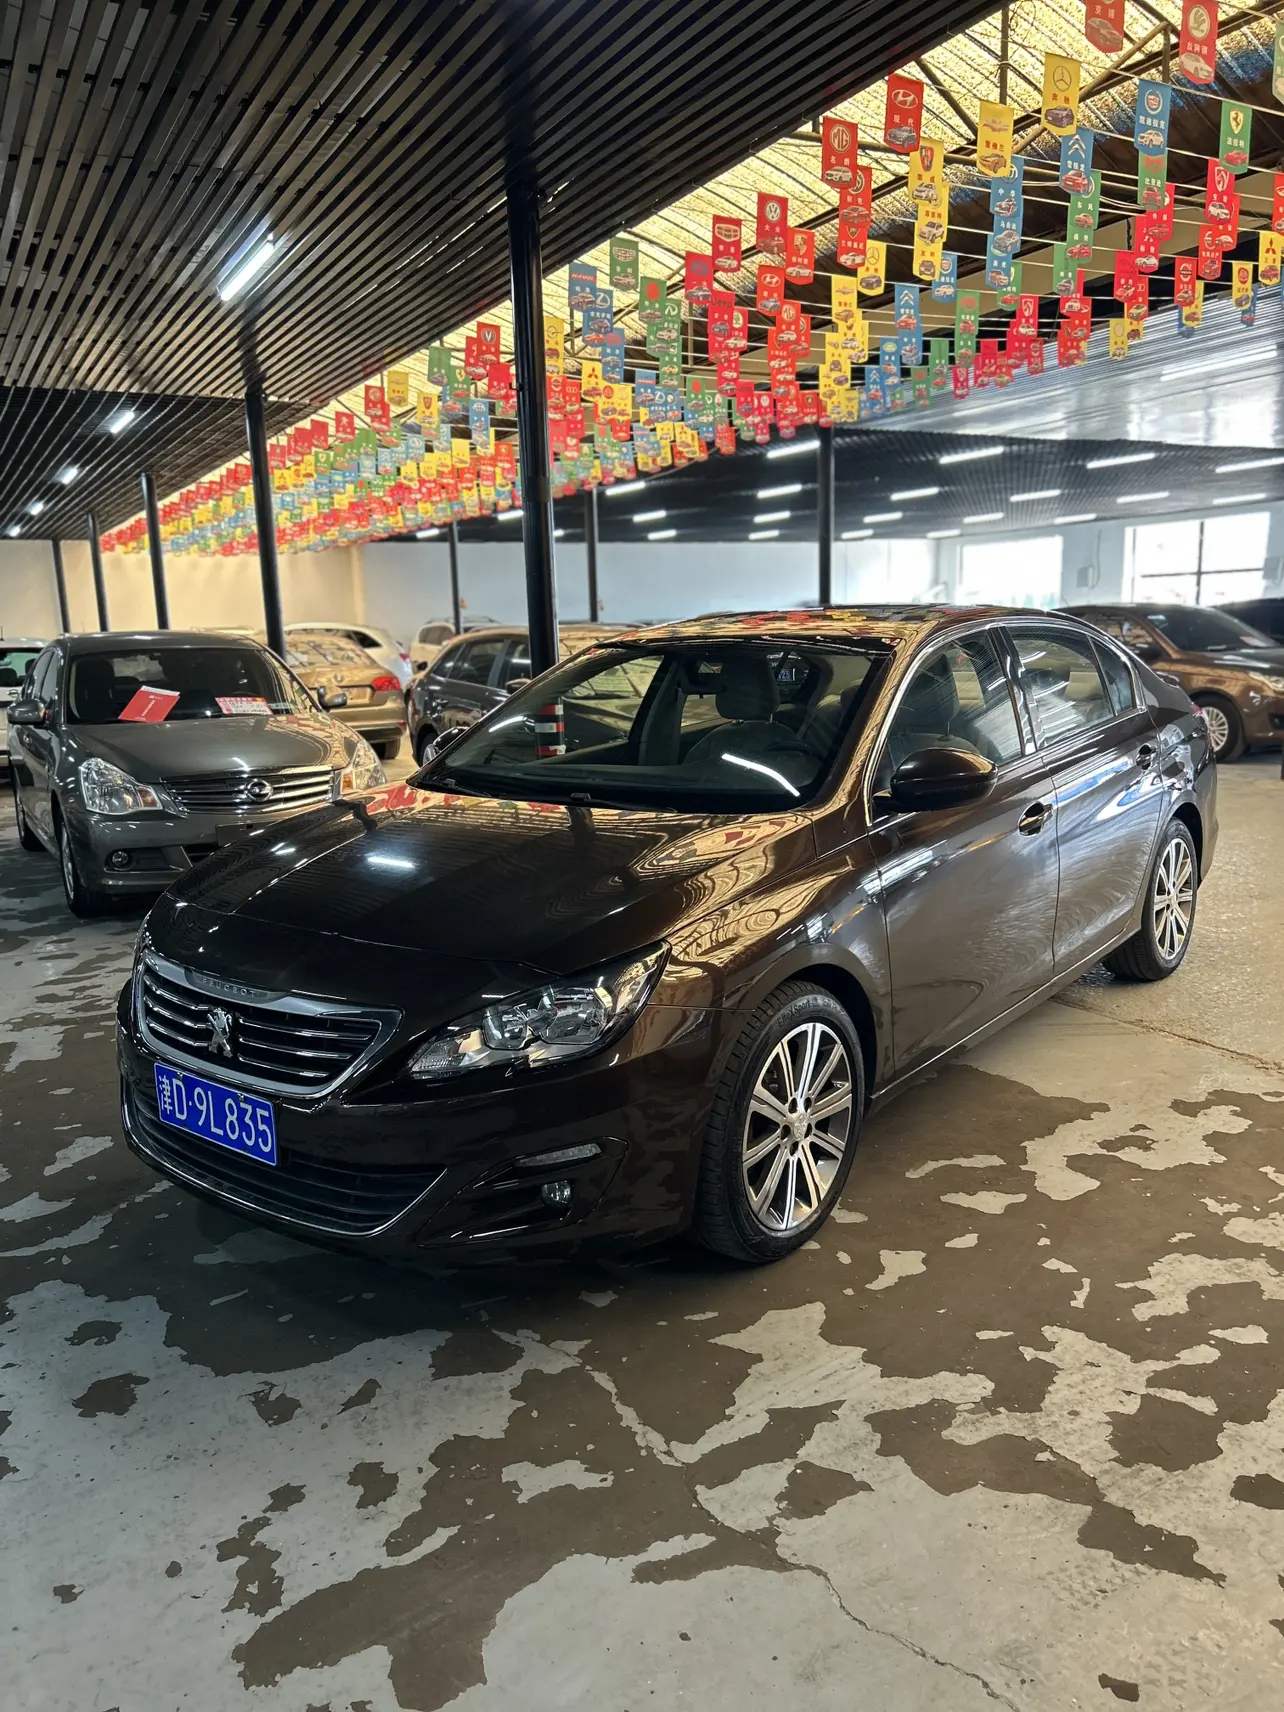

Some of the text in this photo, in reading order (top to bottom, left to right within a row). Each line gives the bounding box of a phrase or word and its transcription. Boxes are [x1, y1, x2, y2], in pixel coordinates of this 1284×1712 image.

[764, 223, 781, 234] 大众
[202, 977, 256, 998] PEUGEOT
[159, 1074, 272, 1153] 津D·9L835
